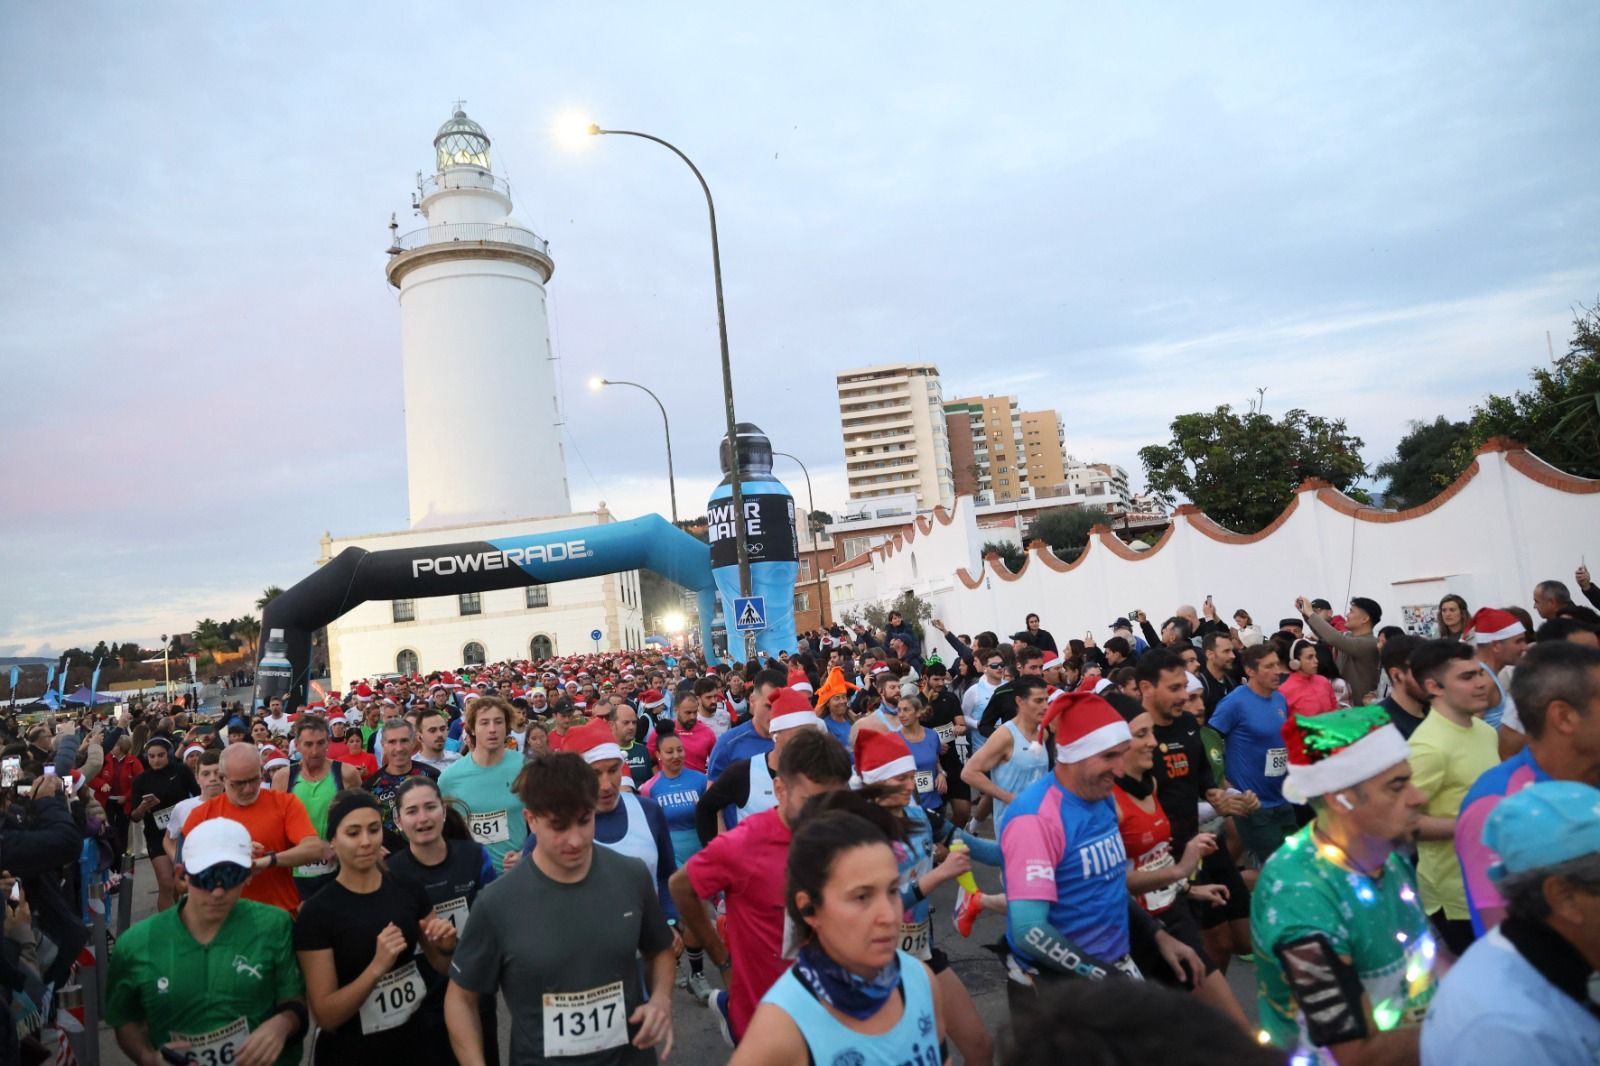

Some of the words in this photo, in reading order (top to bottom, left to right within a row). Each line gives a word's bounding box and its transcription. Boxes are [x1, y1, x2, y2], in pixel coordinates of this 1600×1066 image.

[412, 540, 587, 578] POWERADE
[657, 790, 700, 807] FITCLUB
[473, 820, 499, 835] 651
[375, 981, 417, 1014] 108
[568, 994, 585, 1002] SAN
[553, 1002, 617, 1036] 1317
